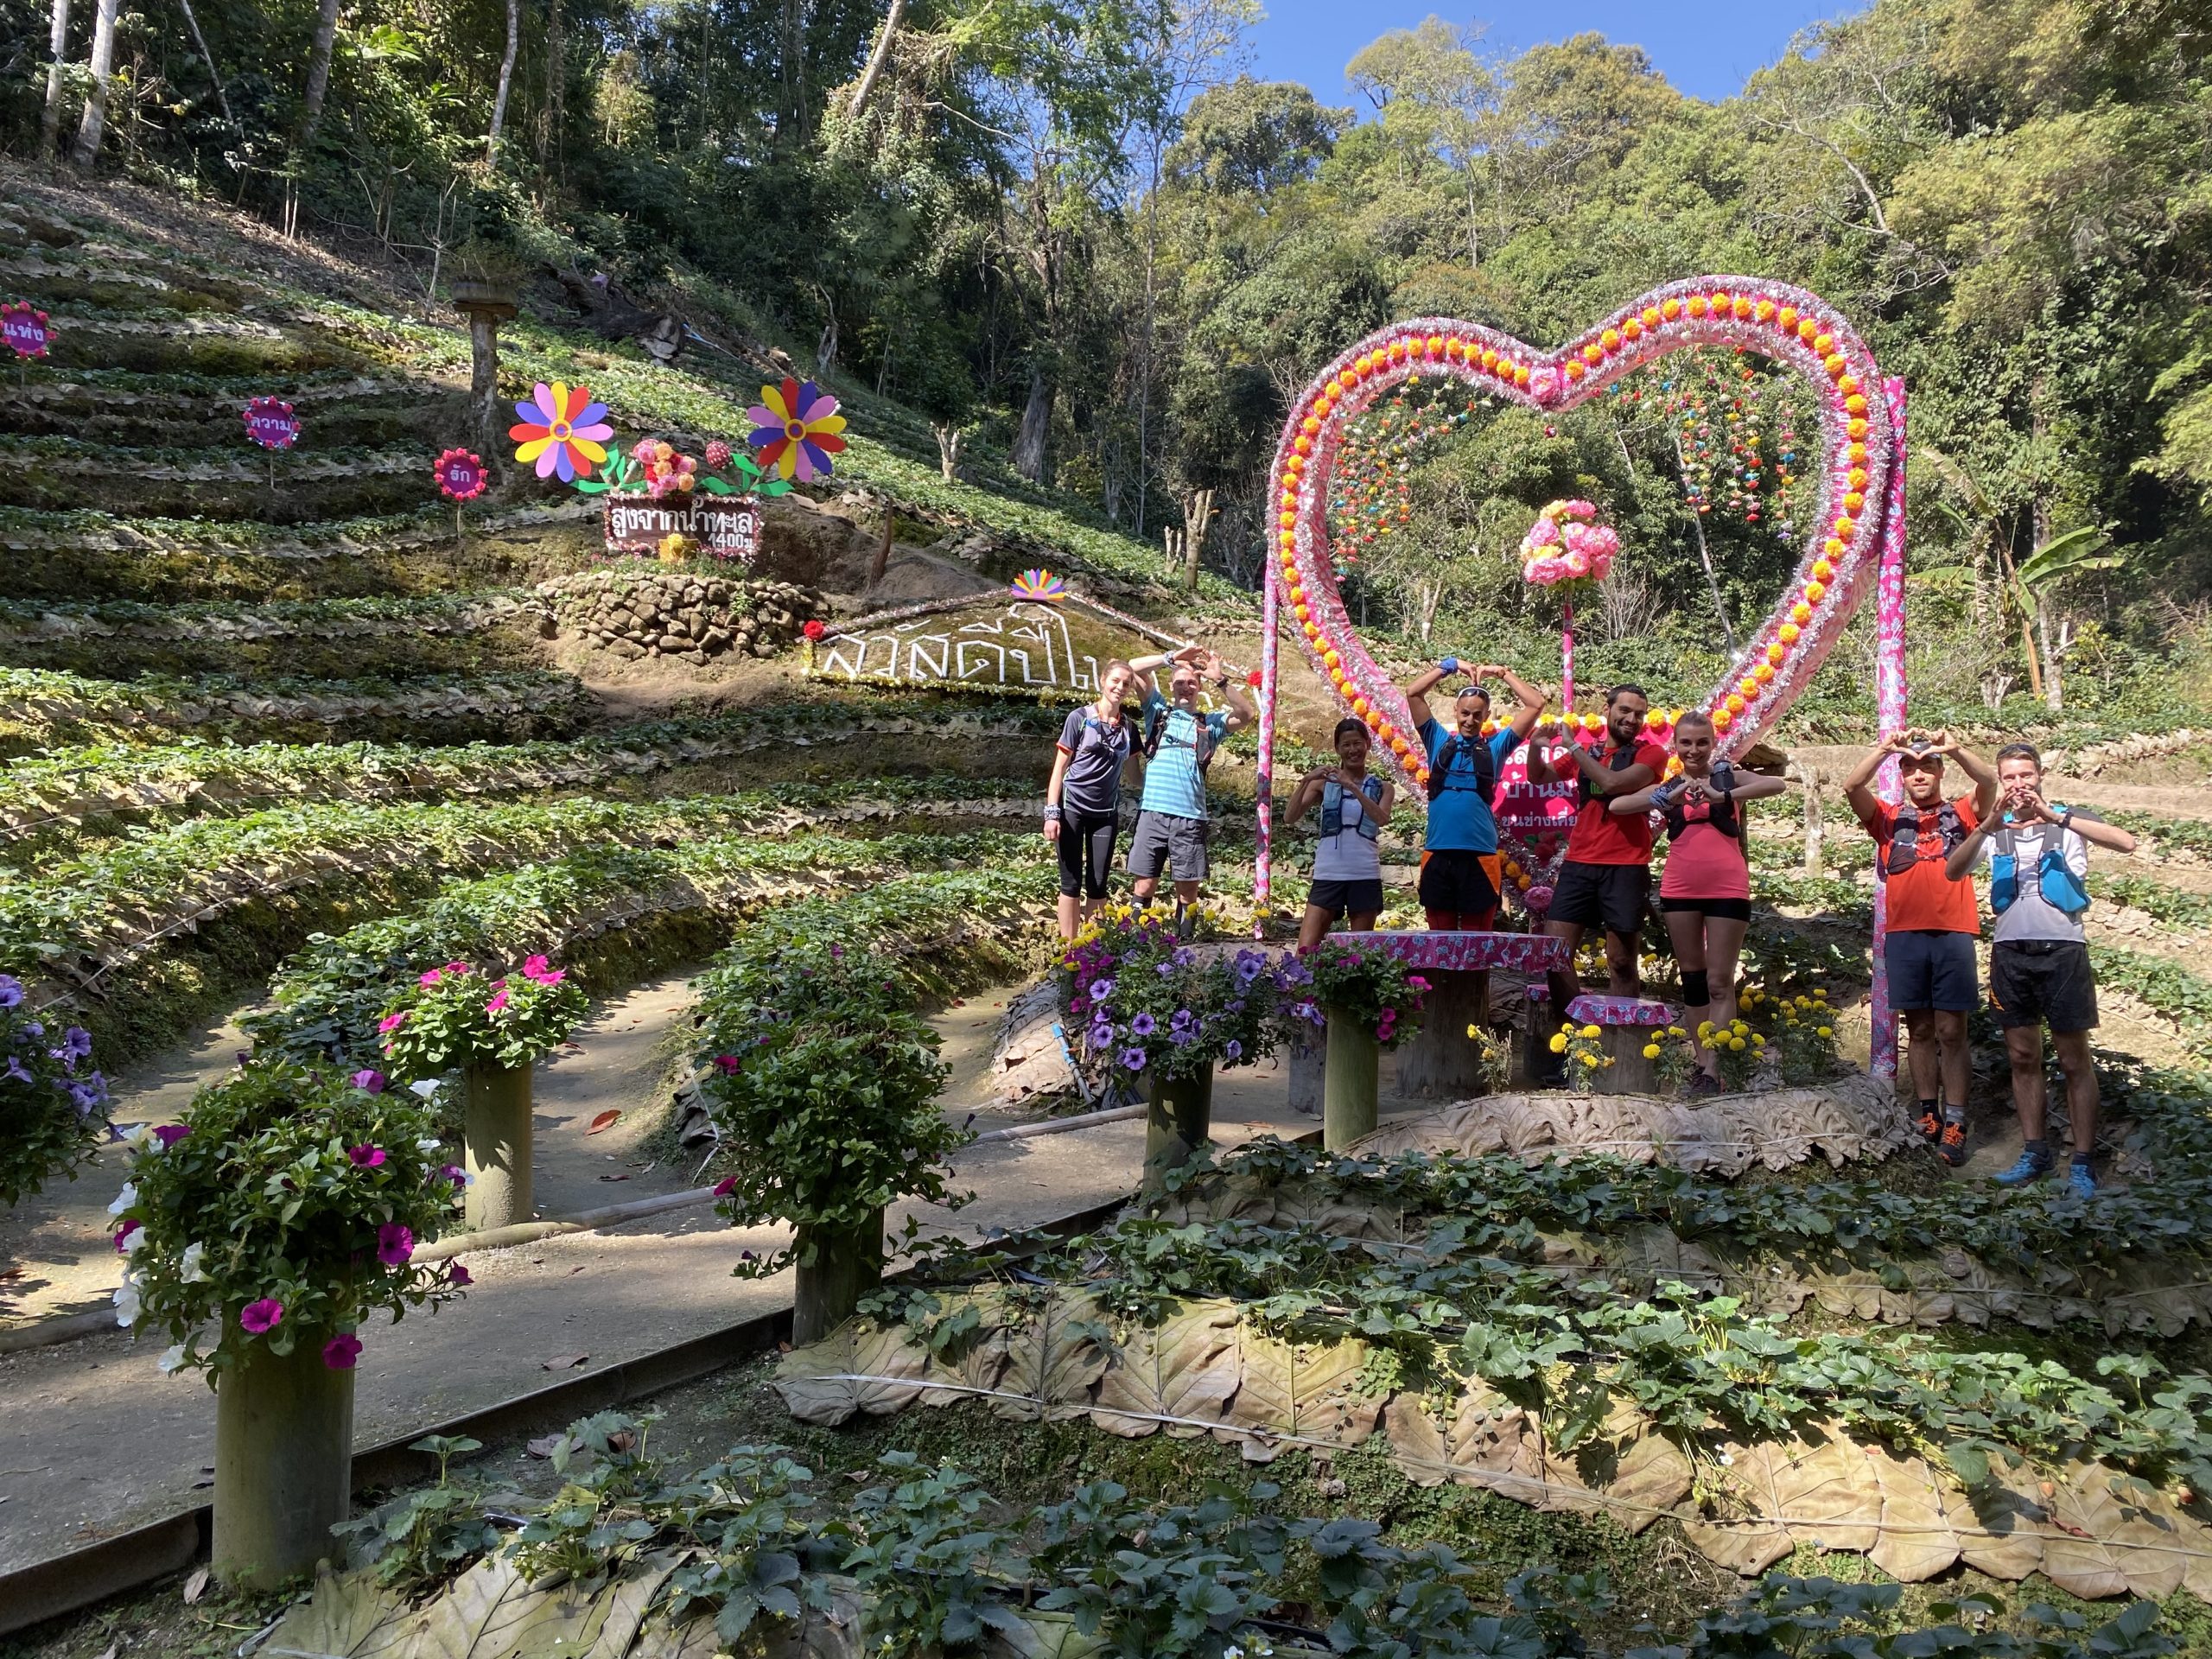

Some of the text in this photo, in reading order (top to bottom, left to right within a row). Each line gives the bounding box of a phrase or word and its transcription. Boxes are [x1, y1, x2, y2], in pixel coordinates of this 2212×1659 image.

[251, 416, 291, 431] ความ
[450, 463, 470, 482] รัก
[611, 499, 753, 537] สูงจากน้ำทะเล
